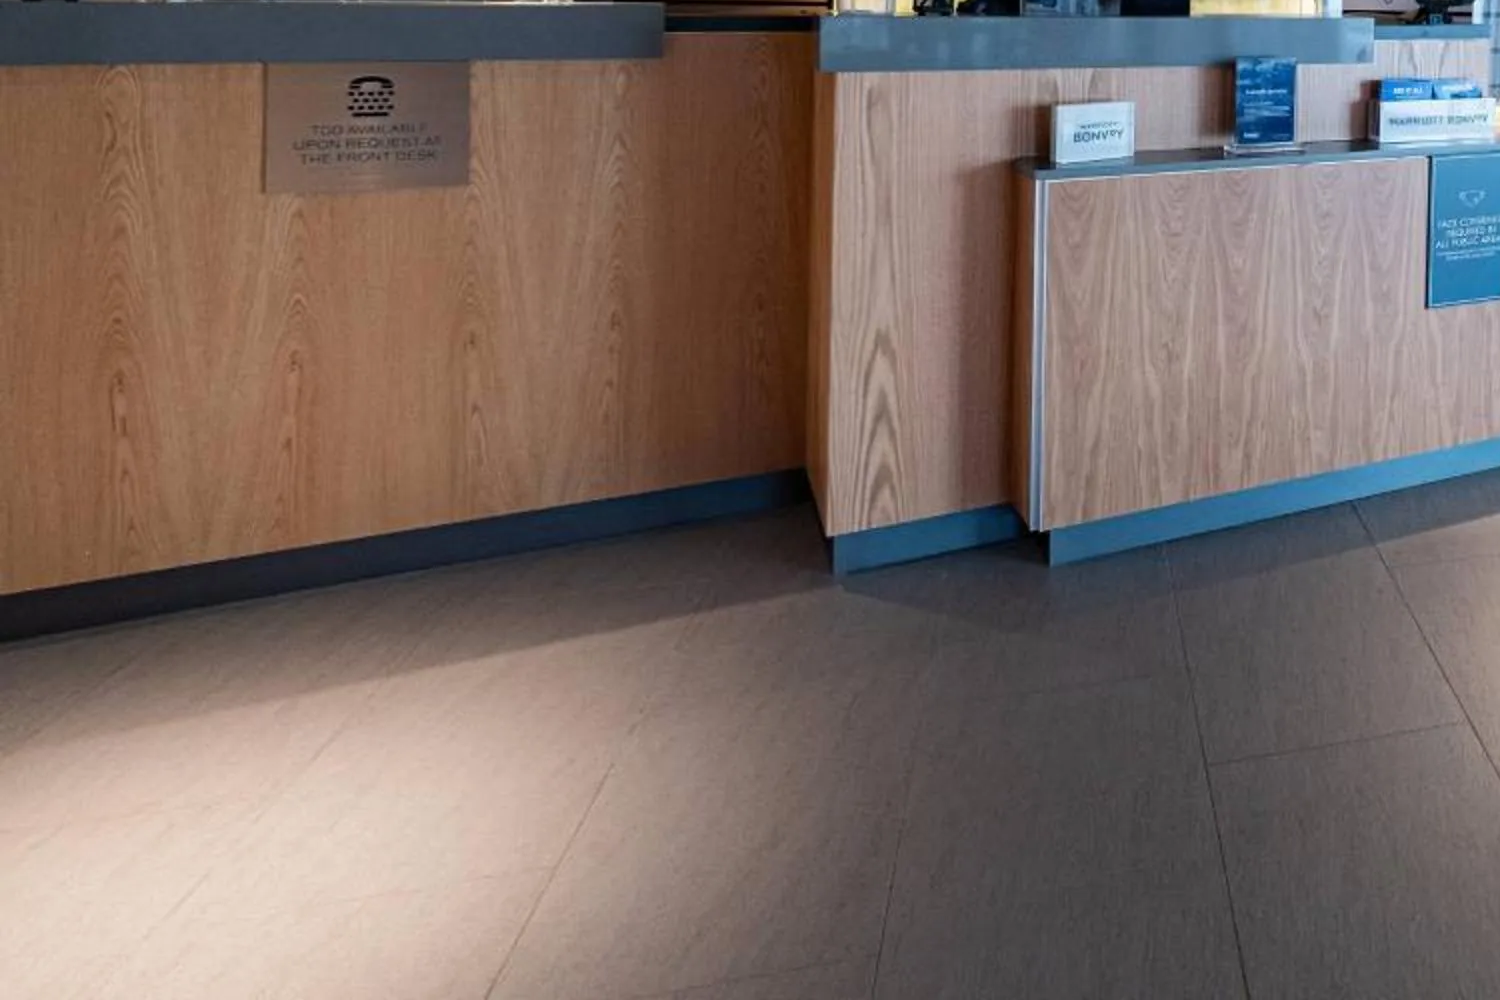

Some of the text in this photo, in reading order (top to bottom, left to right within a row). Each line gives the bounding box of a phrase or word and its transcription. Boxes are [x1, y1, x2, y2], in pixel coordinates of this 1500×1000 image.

[293, 138, 341, 150] UPON
[345, 136, 419, 149] REQUEST
[1073, 127, 1124, 143] BONVOY
[301, 149, 438, 165] THE FRONT DESK
